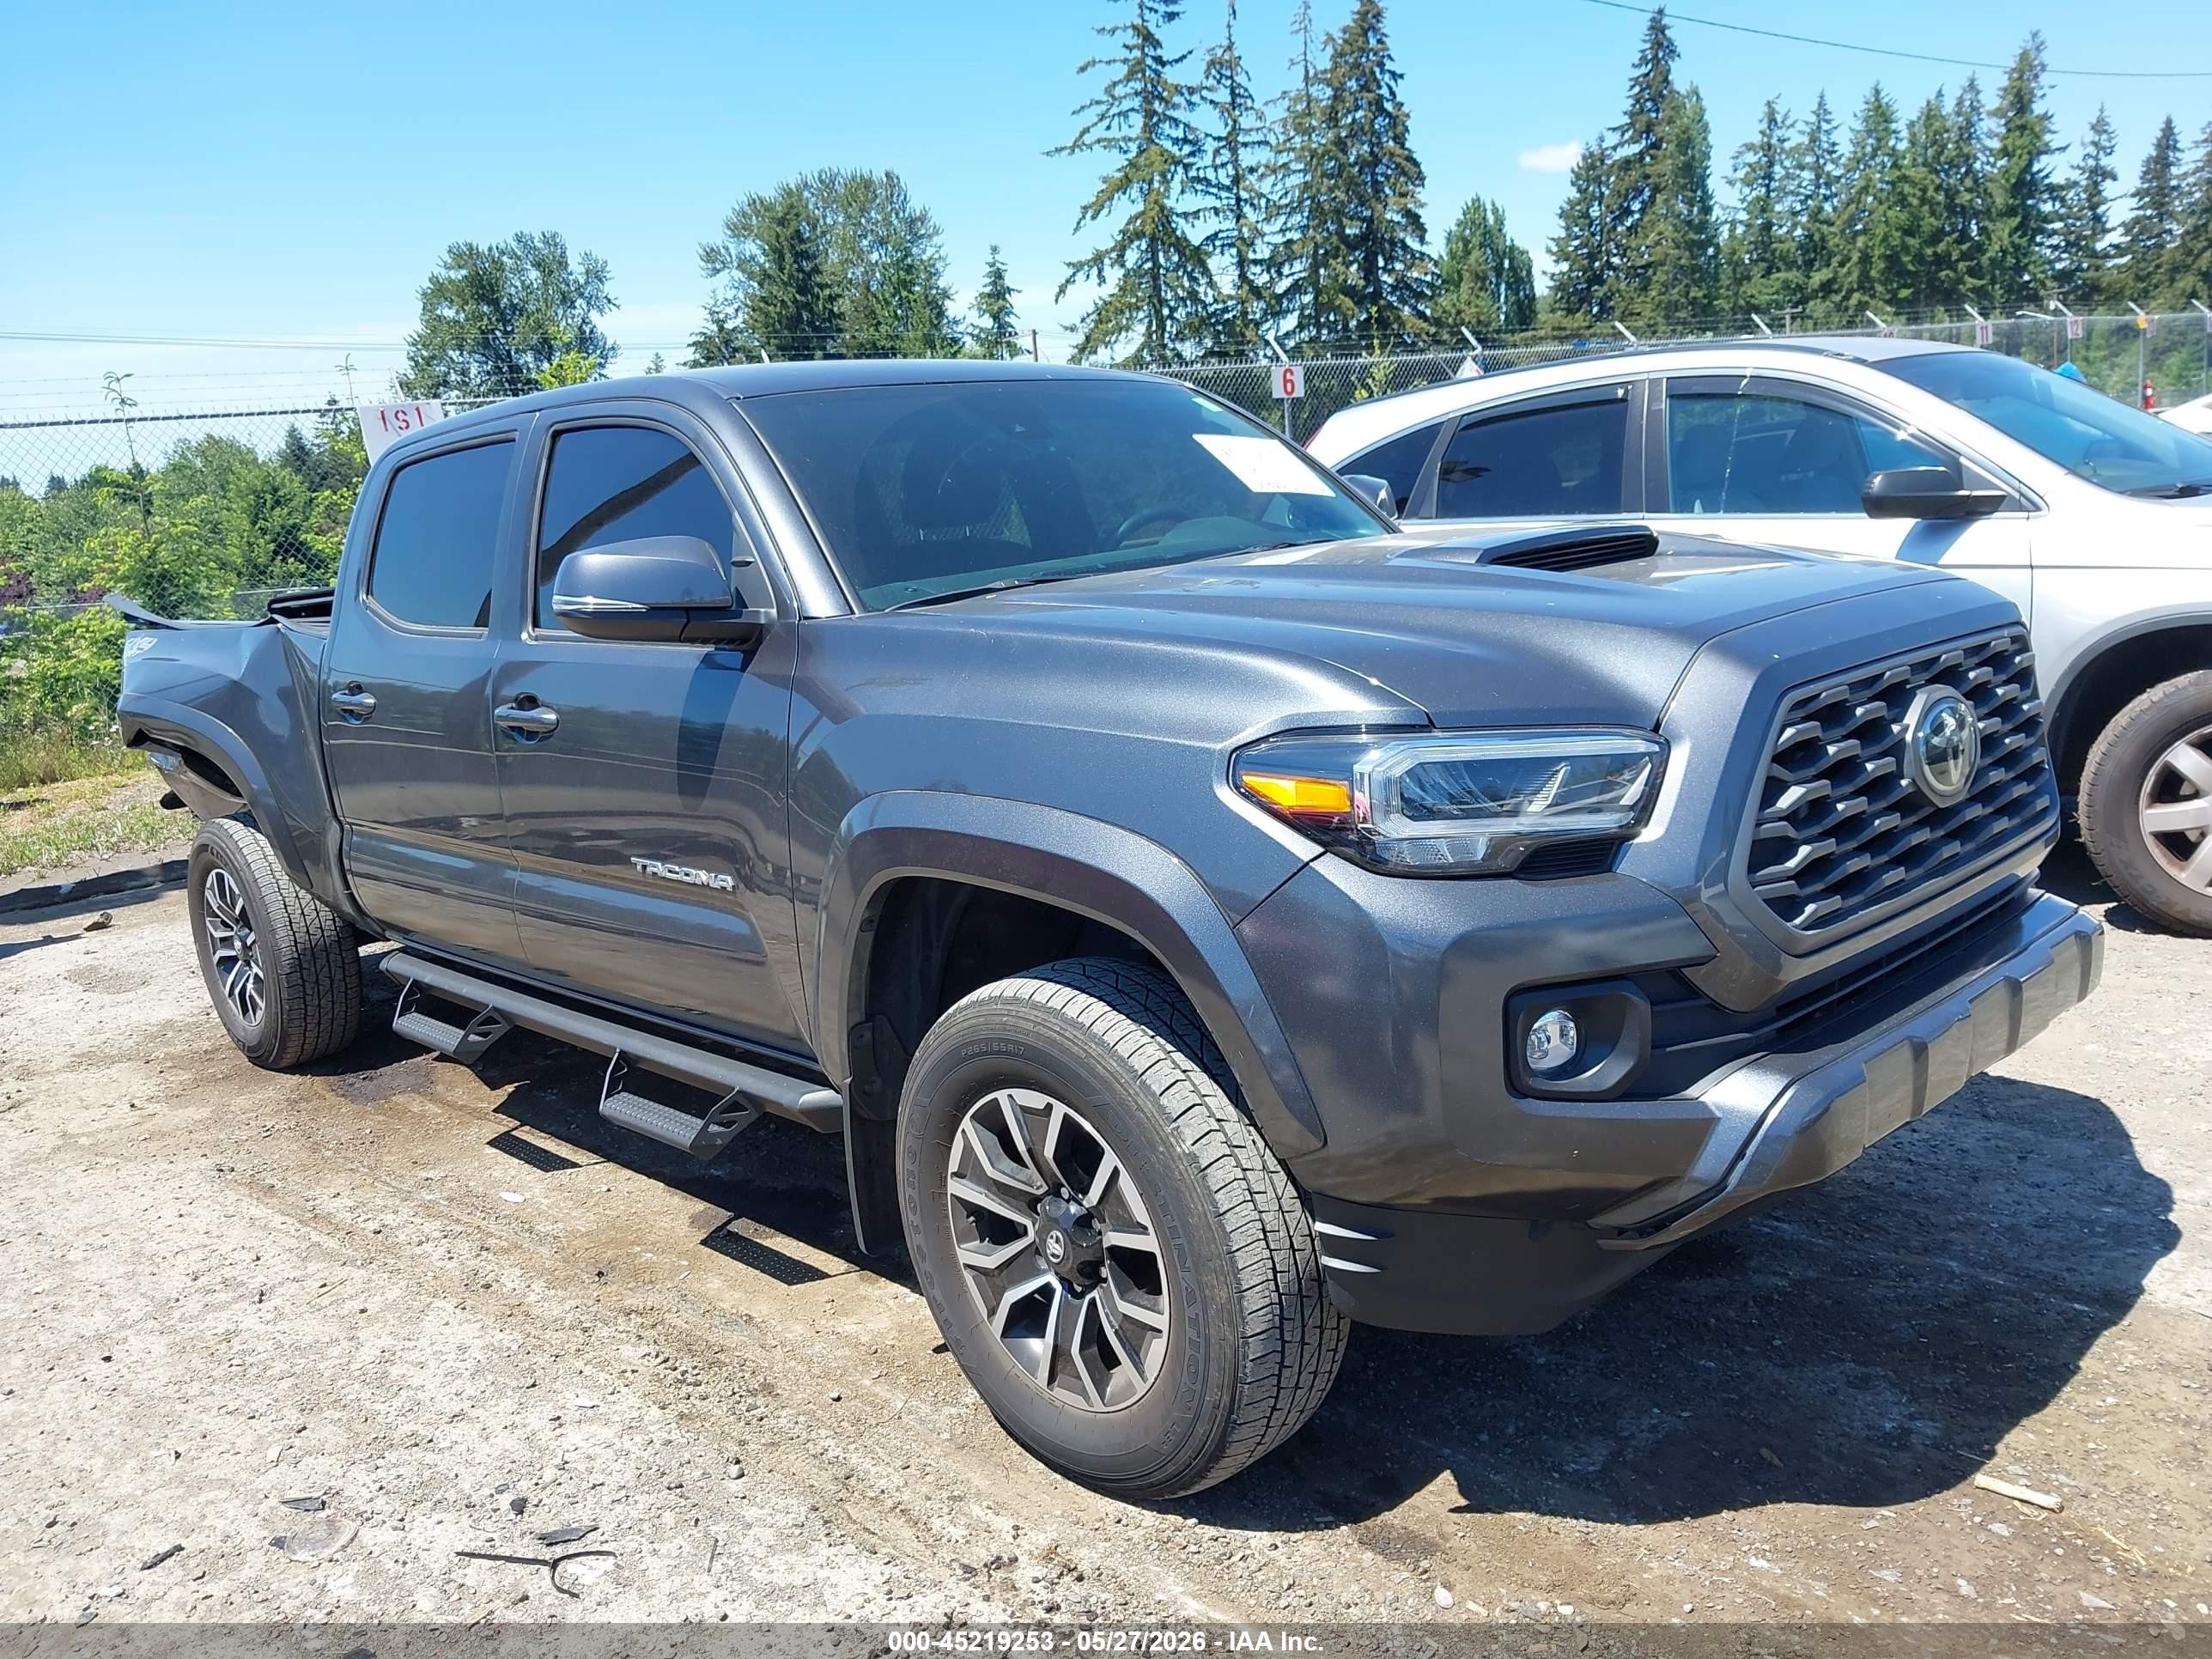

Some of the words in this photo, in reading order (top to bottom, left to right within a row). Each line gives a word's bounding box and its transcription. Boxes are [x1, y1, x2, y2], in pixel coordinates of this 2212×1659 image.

[1980, 325, 1989, 343] 11
[1283, 368, 1295, 397] 6
[630, 856, 736, 892] TACOMA
